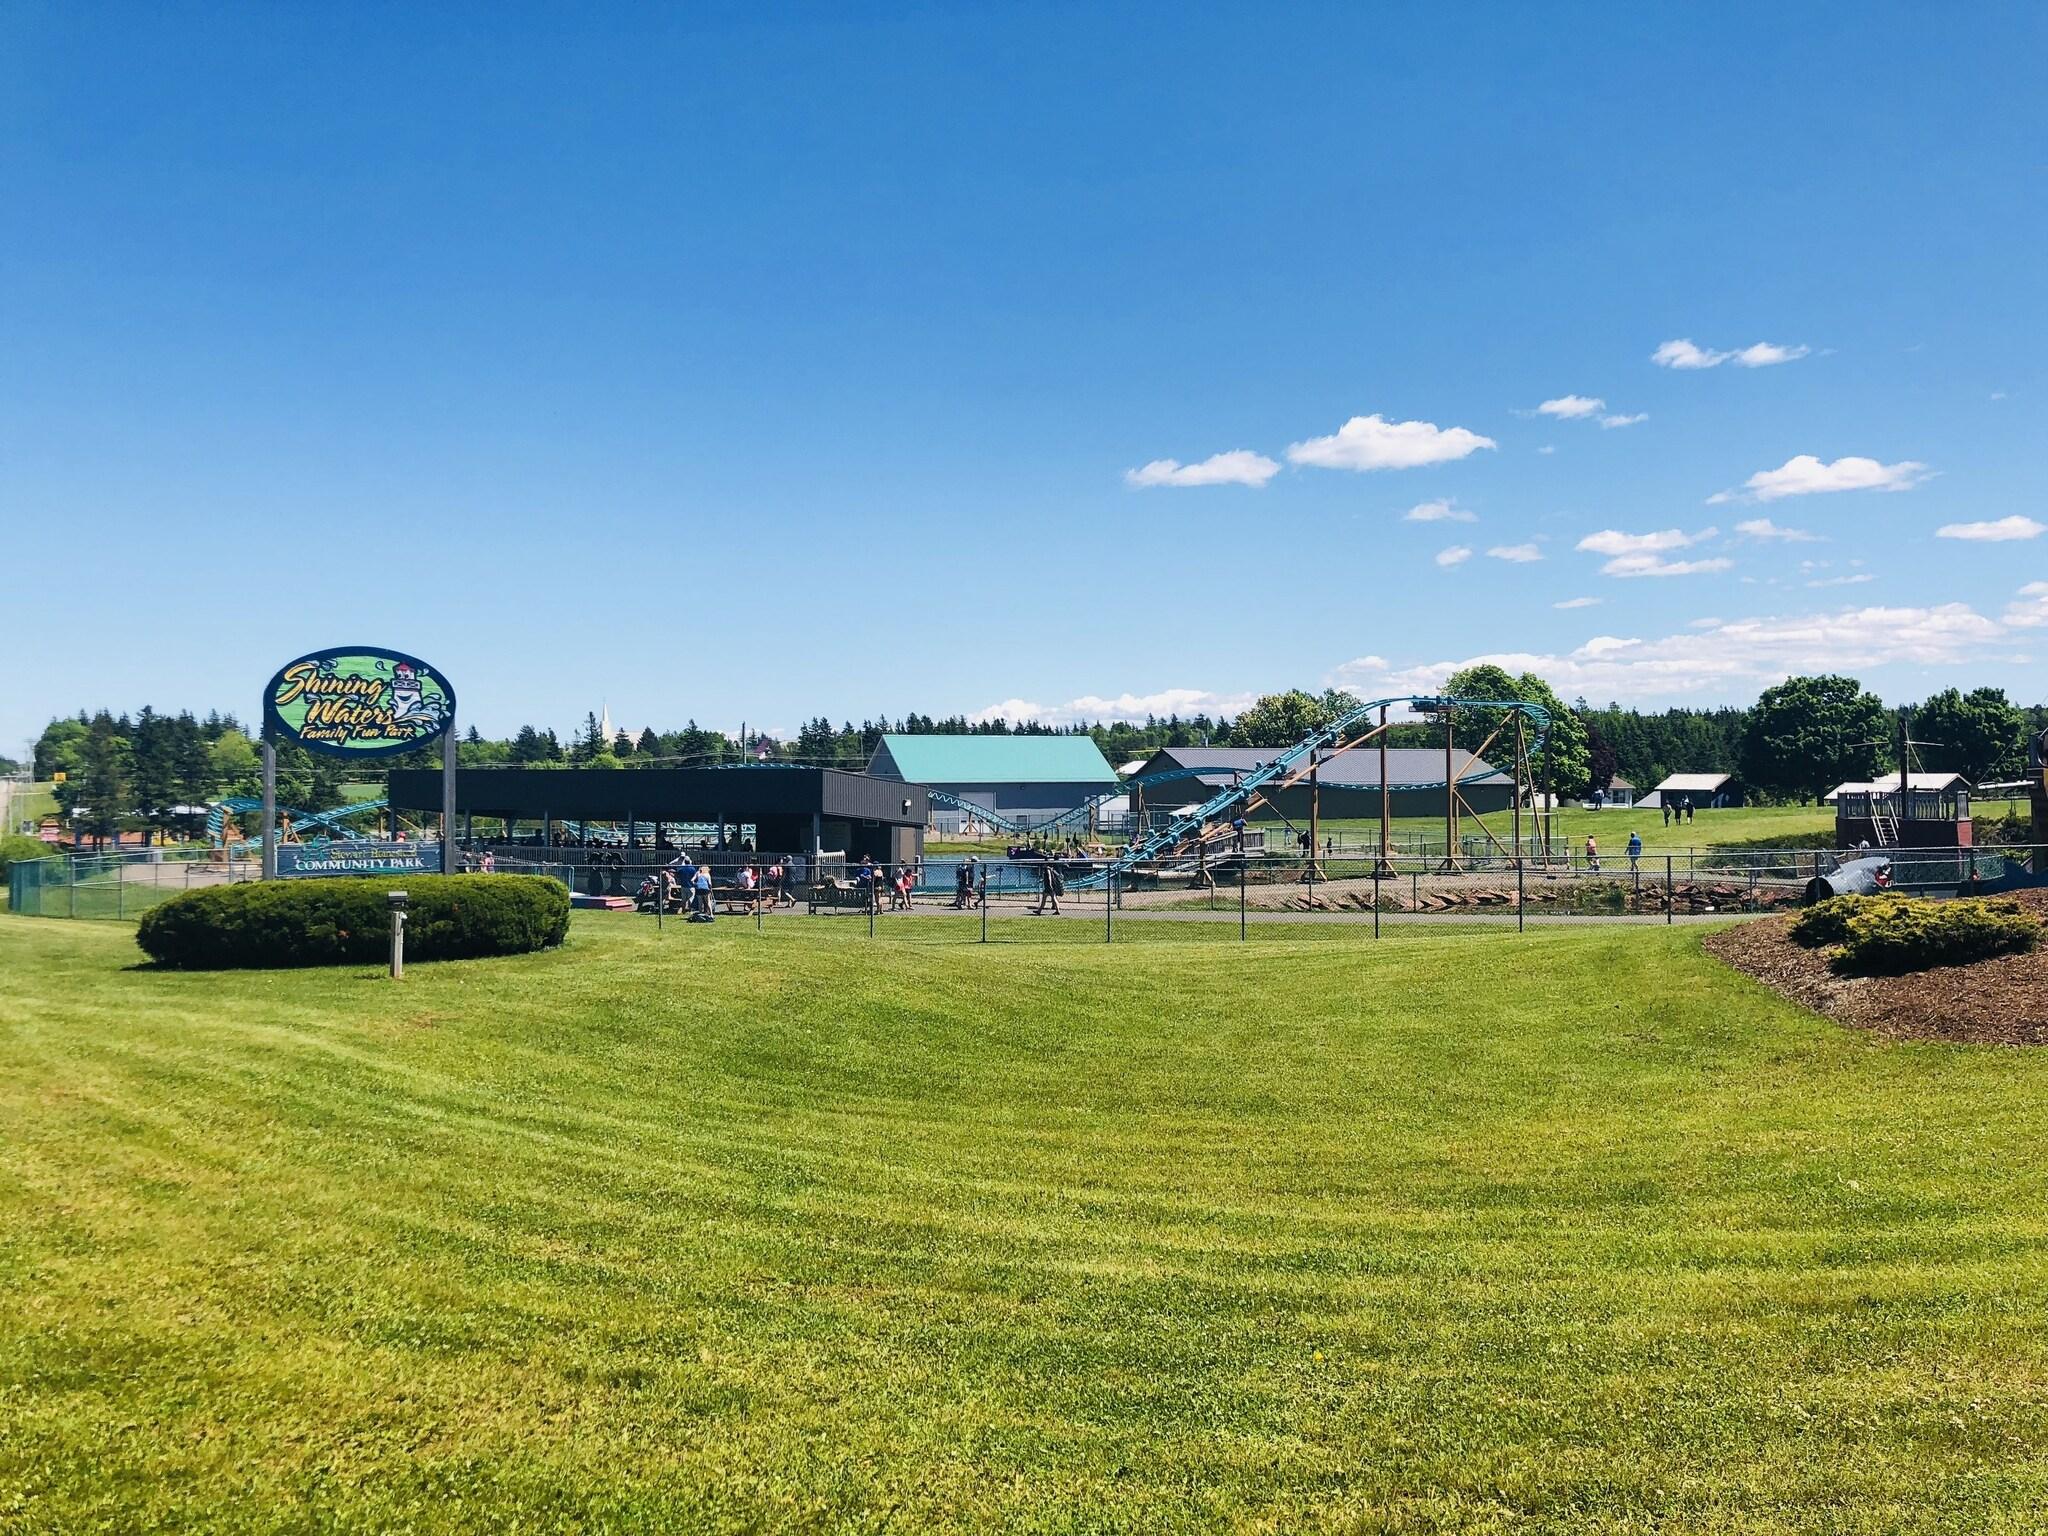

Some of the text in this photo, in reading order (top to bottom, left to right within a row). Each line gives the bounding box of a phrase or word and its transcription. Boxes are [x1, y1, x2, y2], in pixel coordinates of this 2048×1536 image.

[275, 663, 387, 705] Shining
[307, 697, 394, 725] Waters
[300, 724, 415, 744] Family Fun Park
[295, 858, 424, 871] COMMUNITY PARK
